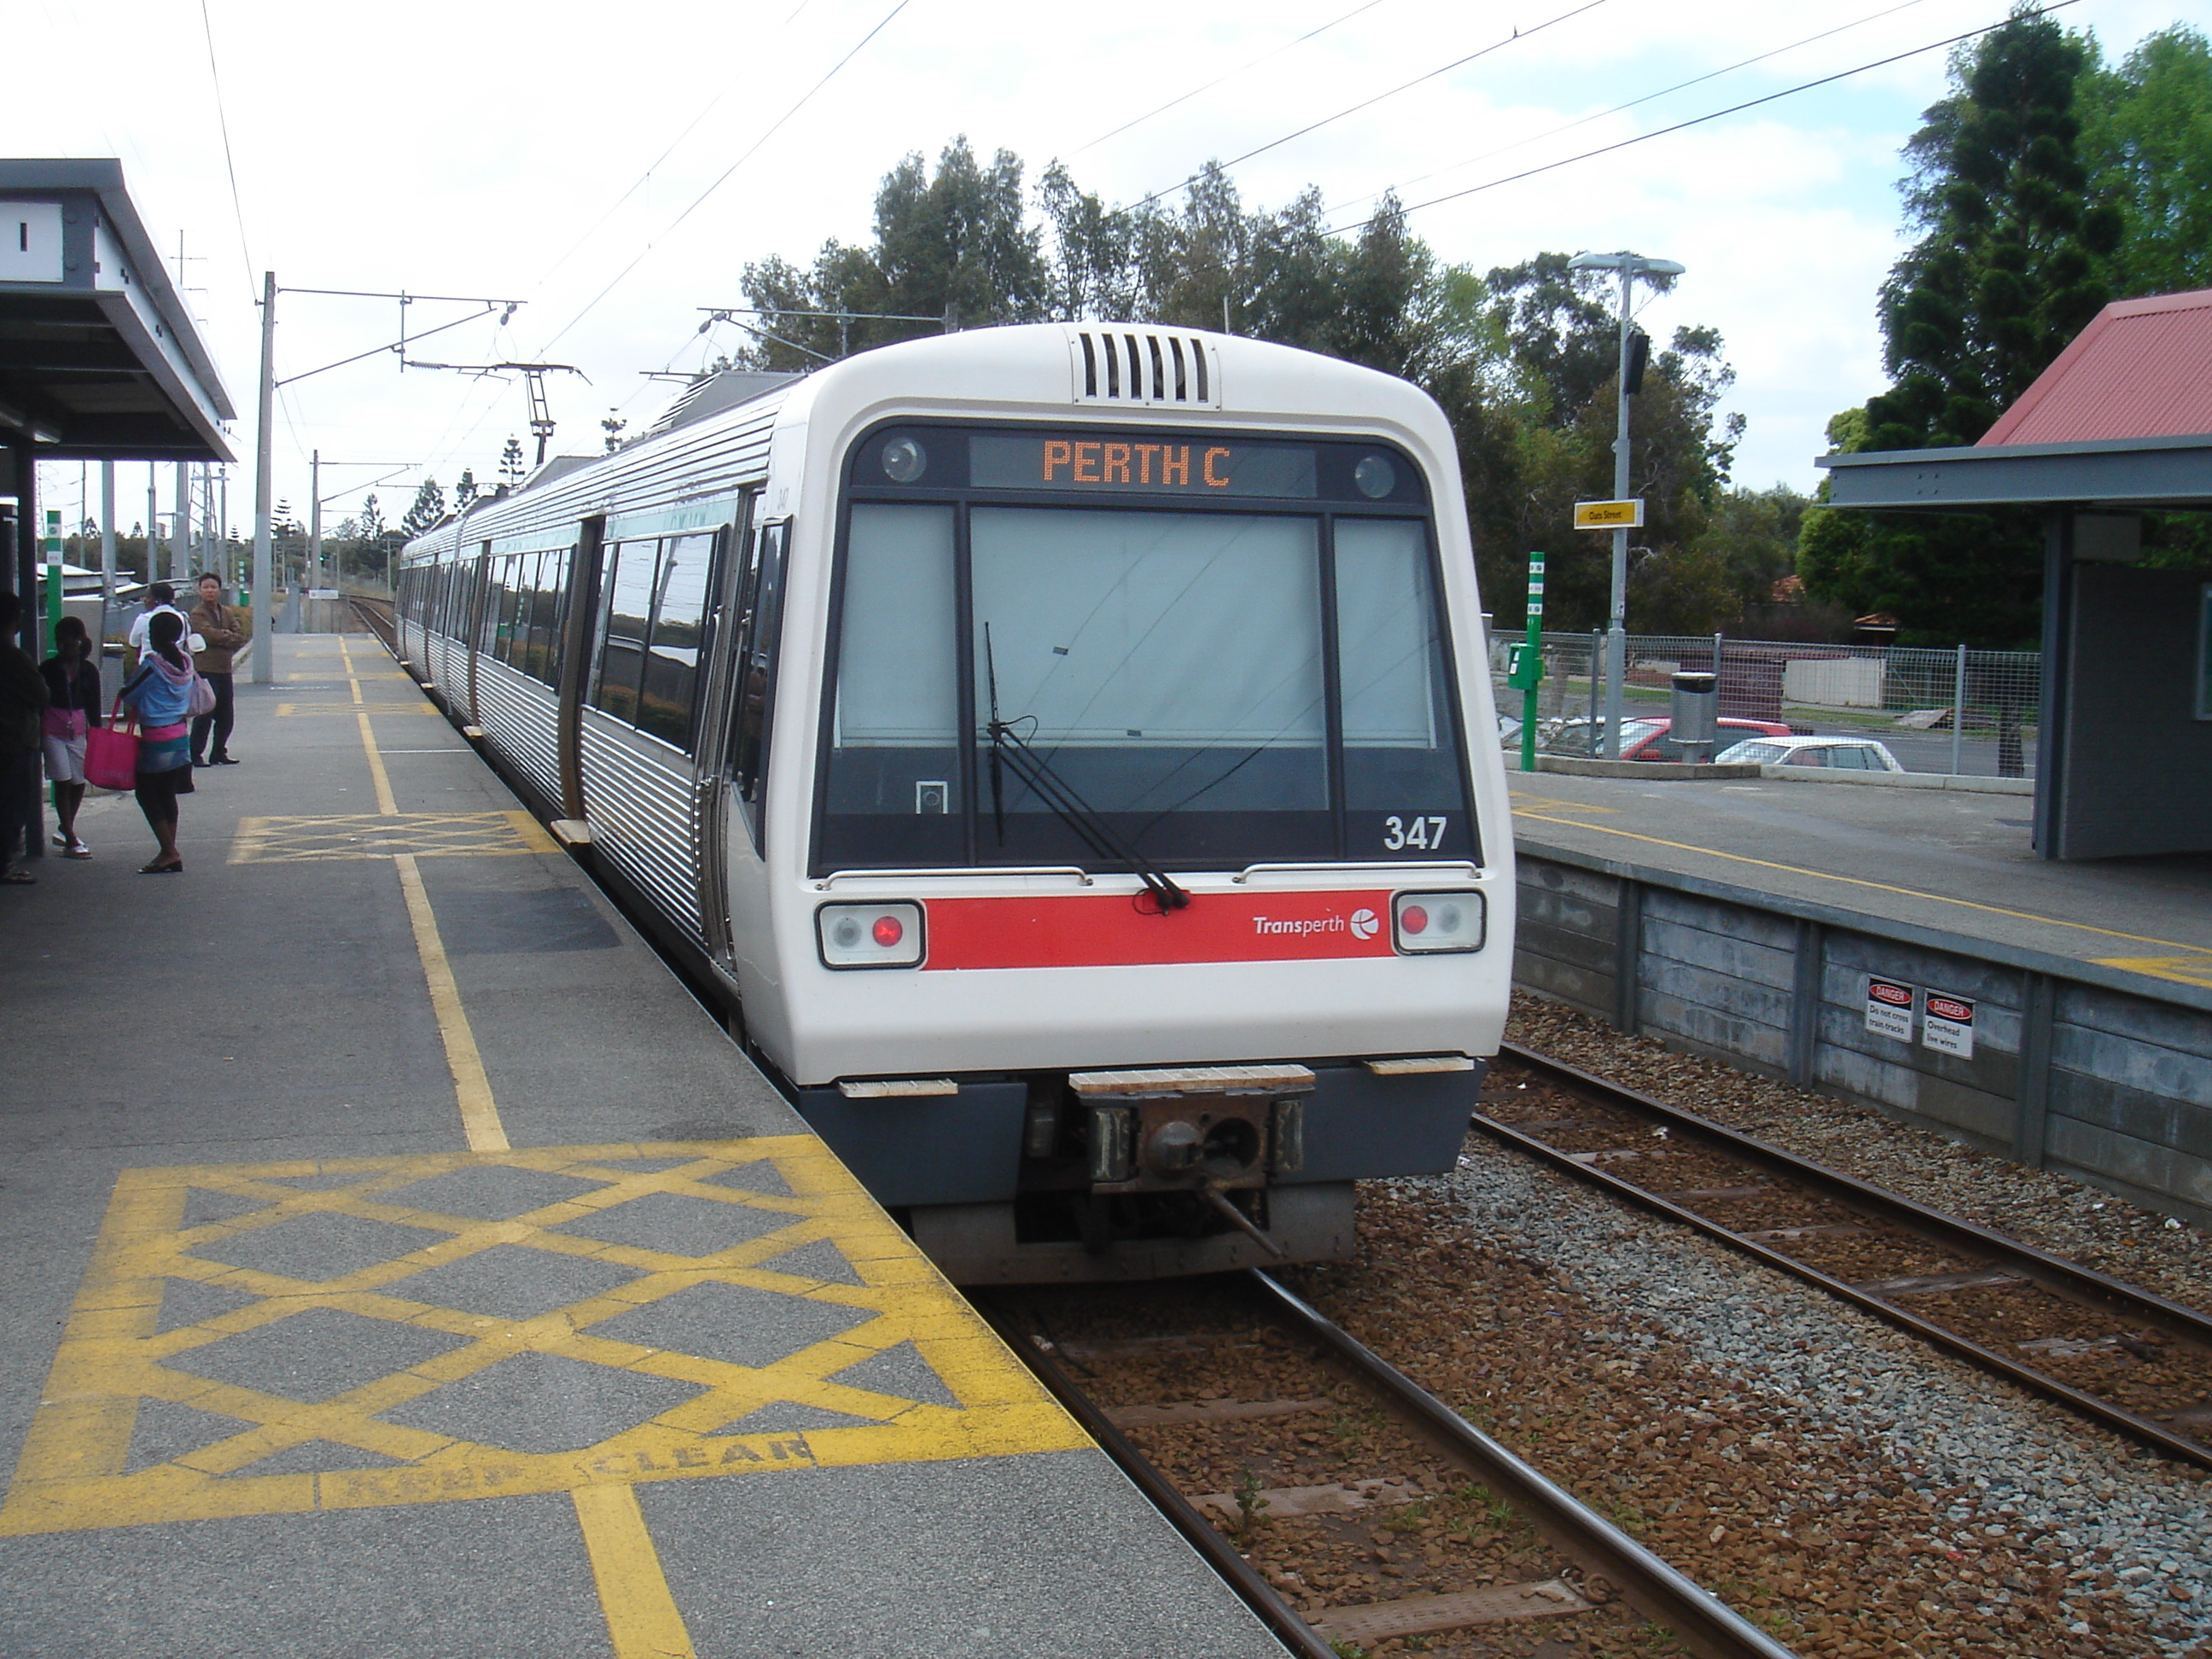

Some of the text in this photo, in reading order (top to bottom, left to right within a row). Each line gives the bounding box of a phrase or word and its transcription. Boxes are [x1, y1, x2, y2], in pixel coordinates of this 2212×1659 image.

[1042, 439, 1231, 487] PERTH C
[1604, 509, 1622, 520] Street
[1382, 815, 1447, 852] 347
[1252, 913, 1345, 938] Transperth
[1876, 986, 1905, 1002] DANGER
[1870, 1004, 1909, 1023] Do not cross
[1933, 1000, 1965, 1017] DANGER
[1869, 1019, 1905, 1034] train tracks
[1927, 1020, 1960, 1037] Overhead
[1926, 1033, 1958, 1050] live wires
[591, 1438, 811, 1476] CLEAR
